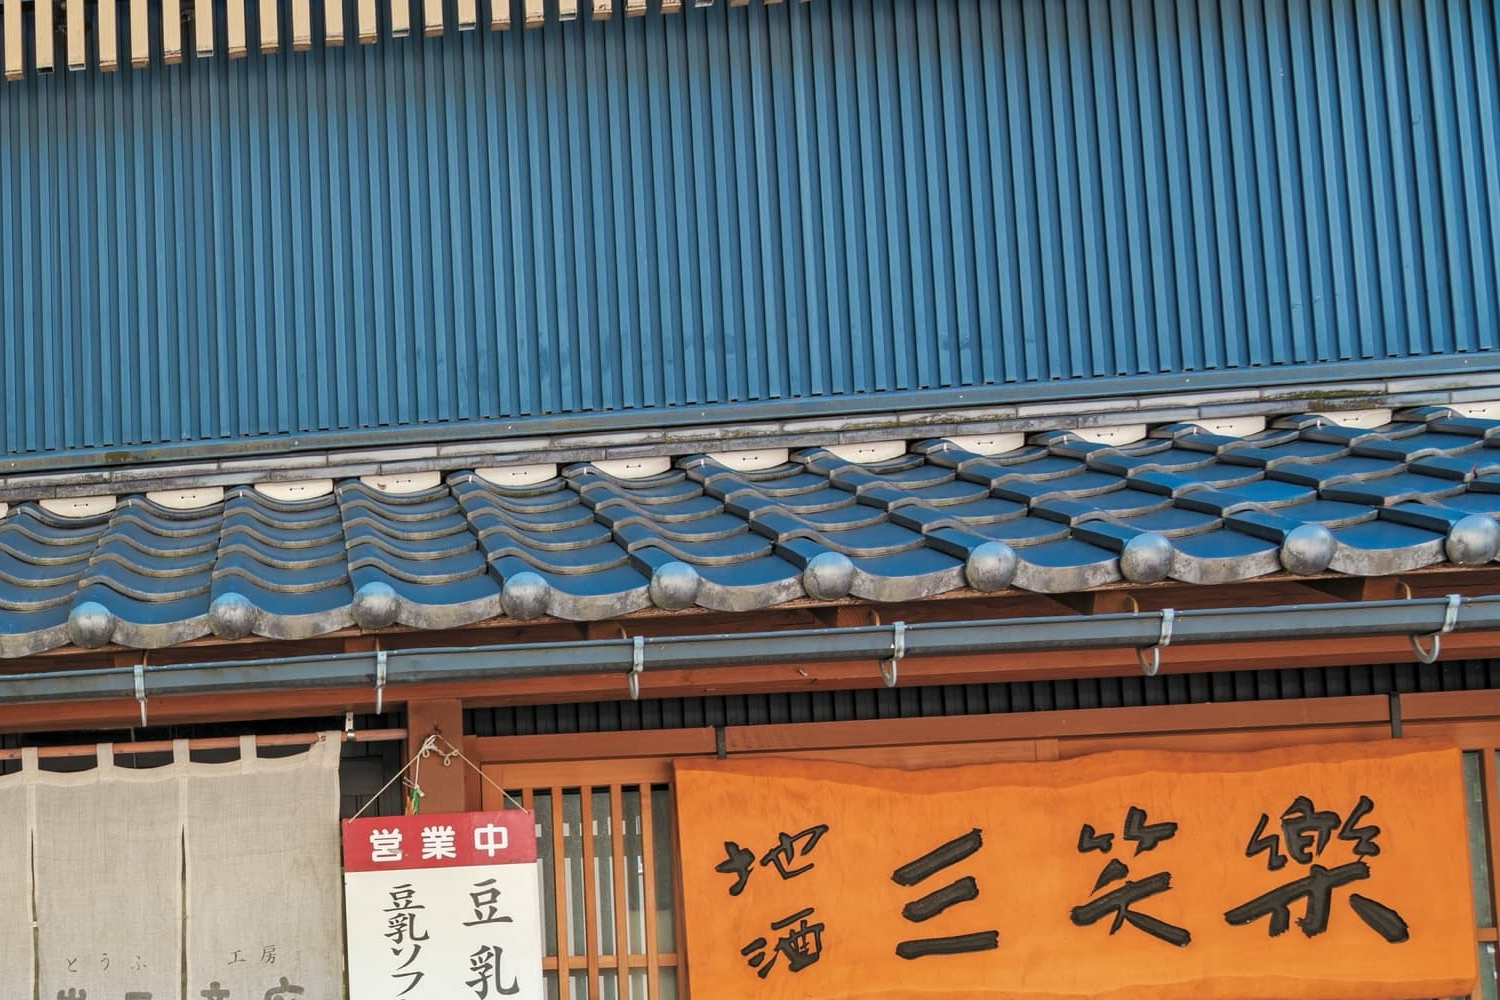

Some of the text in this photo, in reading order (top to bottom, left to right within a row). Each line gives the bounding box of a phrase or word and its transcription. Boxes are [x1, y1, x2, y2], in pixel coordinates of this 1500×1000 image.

[369, 823, 509, 863] 営業中
[714, 823, 830, 980] 地酒
[66, 944, 277, 973] とうふ 工房
